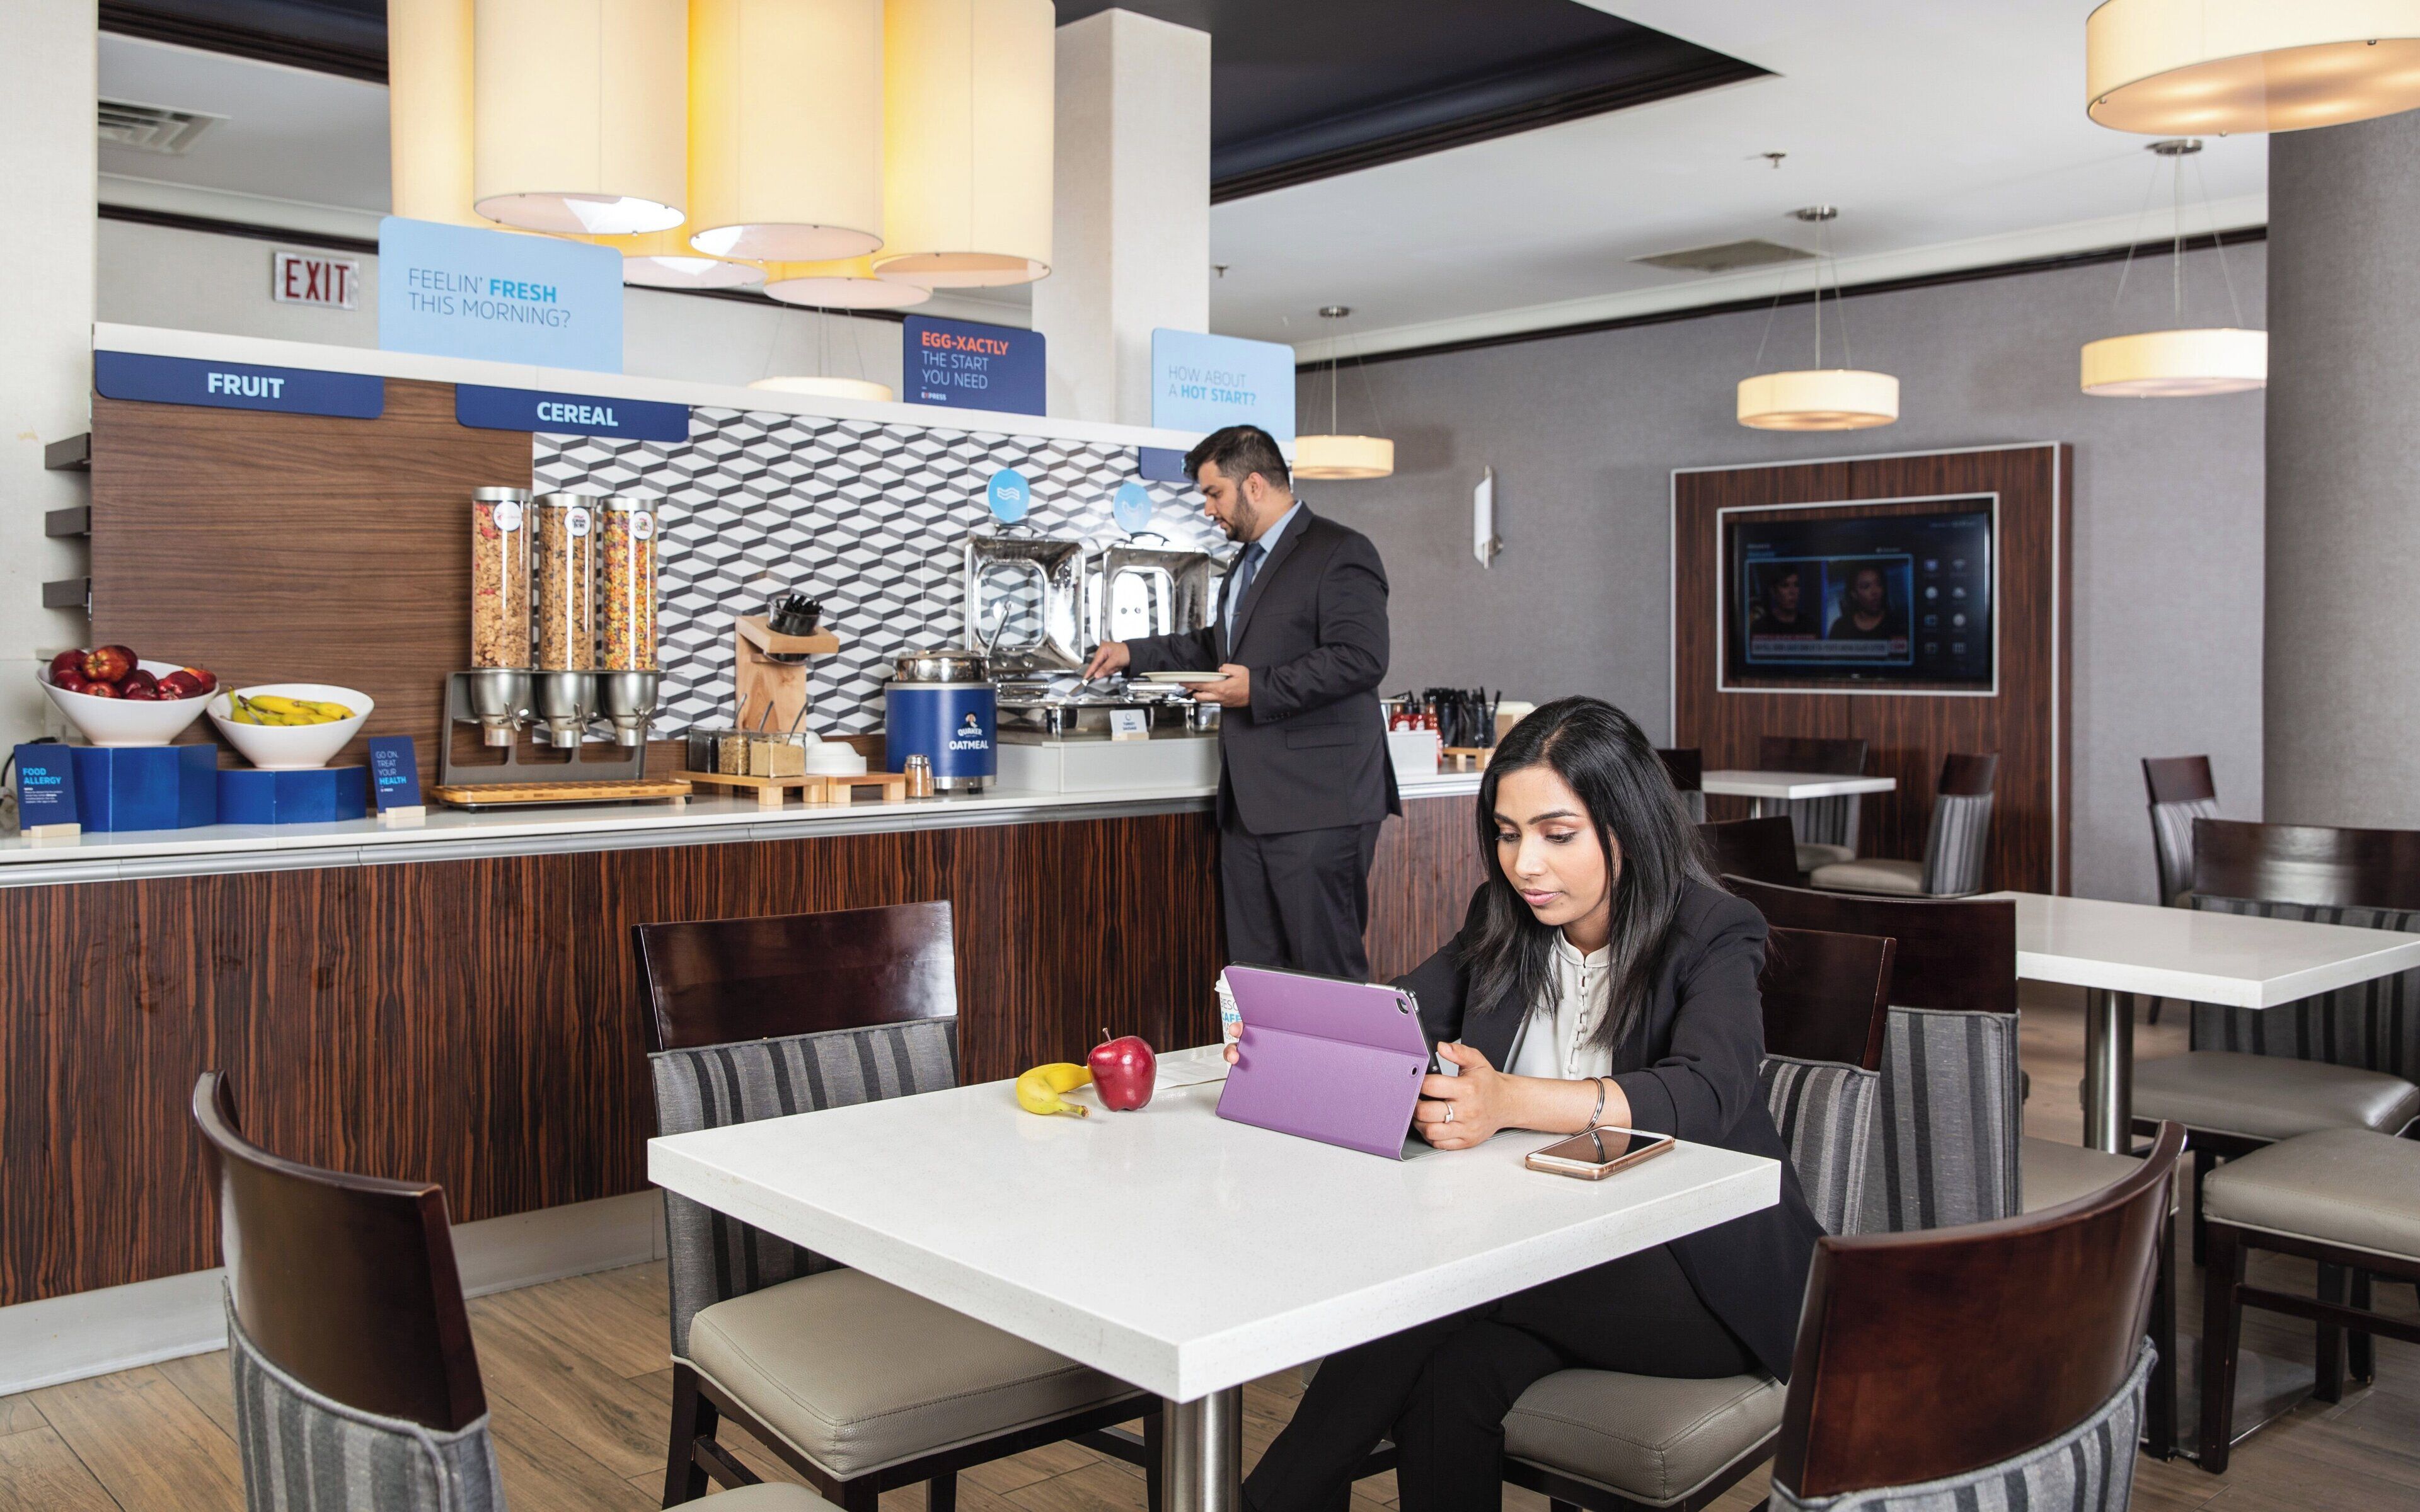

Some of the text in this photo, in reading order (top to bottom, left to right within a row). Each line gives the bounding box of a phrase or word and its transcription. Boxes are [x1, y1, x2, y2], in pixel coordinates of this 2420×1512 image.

[285, 259, 350, 304] EXIT
[489, 278, 557, 304] FRESH
[408, 291, 571, 328] THIS MORNING?
[921, 331, 1009, 355] EGG-XACTLY
[921, 350, 989, 372] THE START
[208, 372, 284, 399] FRUIT
[921, 369, 988, 389] YOU NEED
[1168, 365, 1246, 387] HOW ABOUT
[1168, 383, 1257, 406] A HOT START?
[536, 401, 618, 427] CEREAL
[957, 728, 983, 736] QUAKER
[948, 740, 989, 750] OATMEAL
[22, 767, 47, 776] FOOD
[377, 759, 396, 767] TREAT
[377, 768, 397, 776] YOUR
[23, 776, 62, 784] ALLERGY
[379, 777, 407, 785] HEALTH
